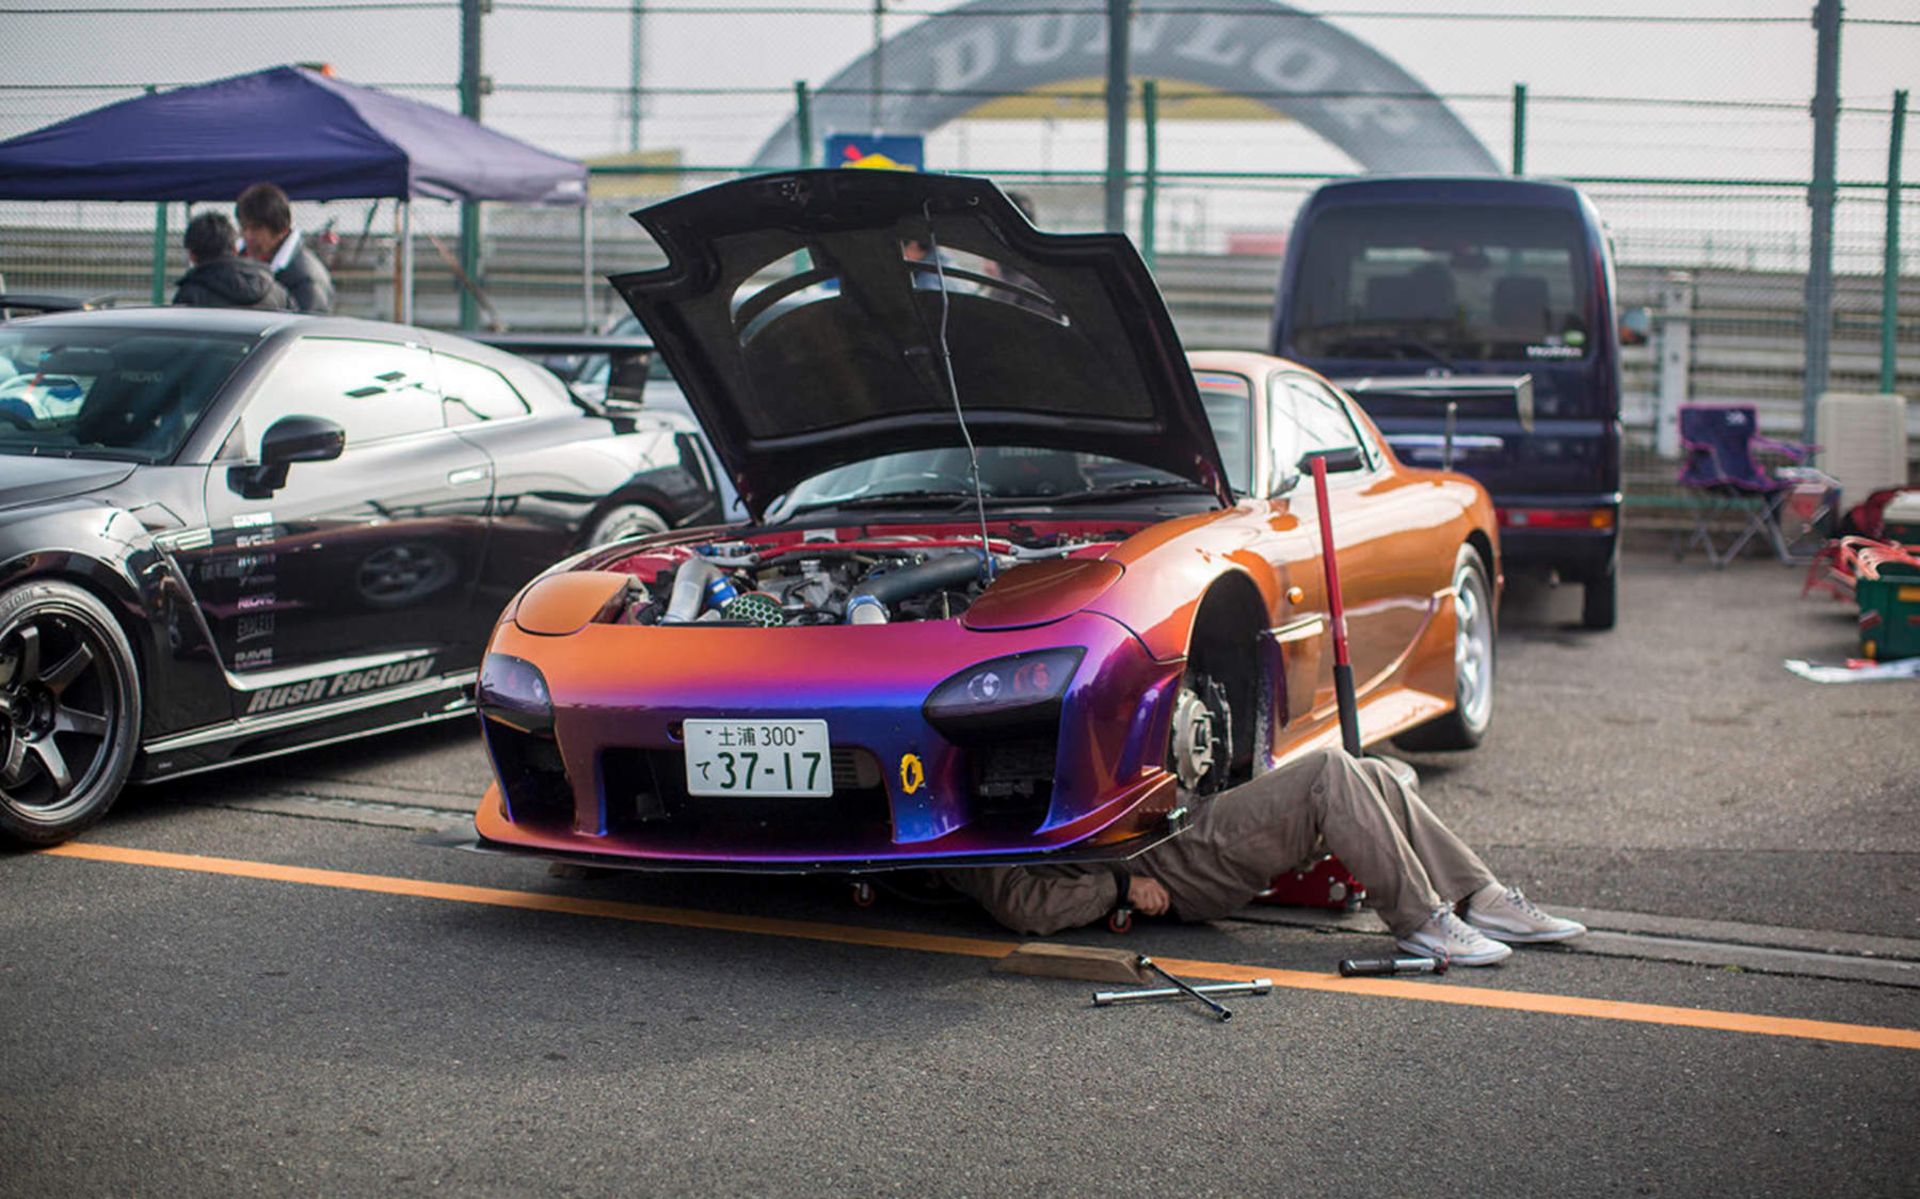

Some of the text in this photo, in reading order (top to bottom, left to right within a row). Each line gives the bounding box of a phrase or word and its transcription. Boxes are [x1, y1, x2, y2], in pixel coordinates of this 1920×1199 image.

[930, 12, 1420, 133] DUNLOP
[247, 657, 435, 713] Rush Factory
[718, 726, 796, 746] 土浦 300
[695, 752, 821, 790] て 37-17
